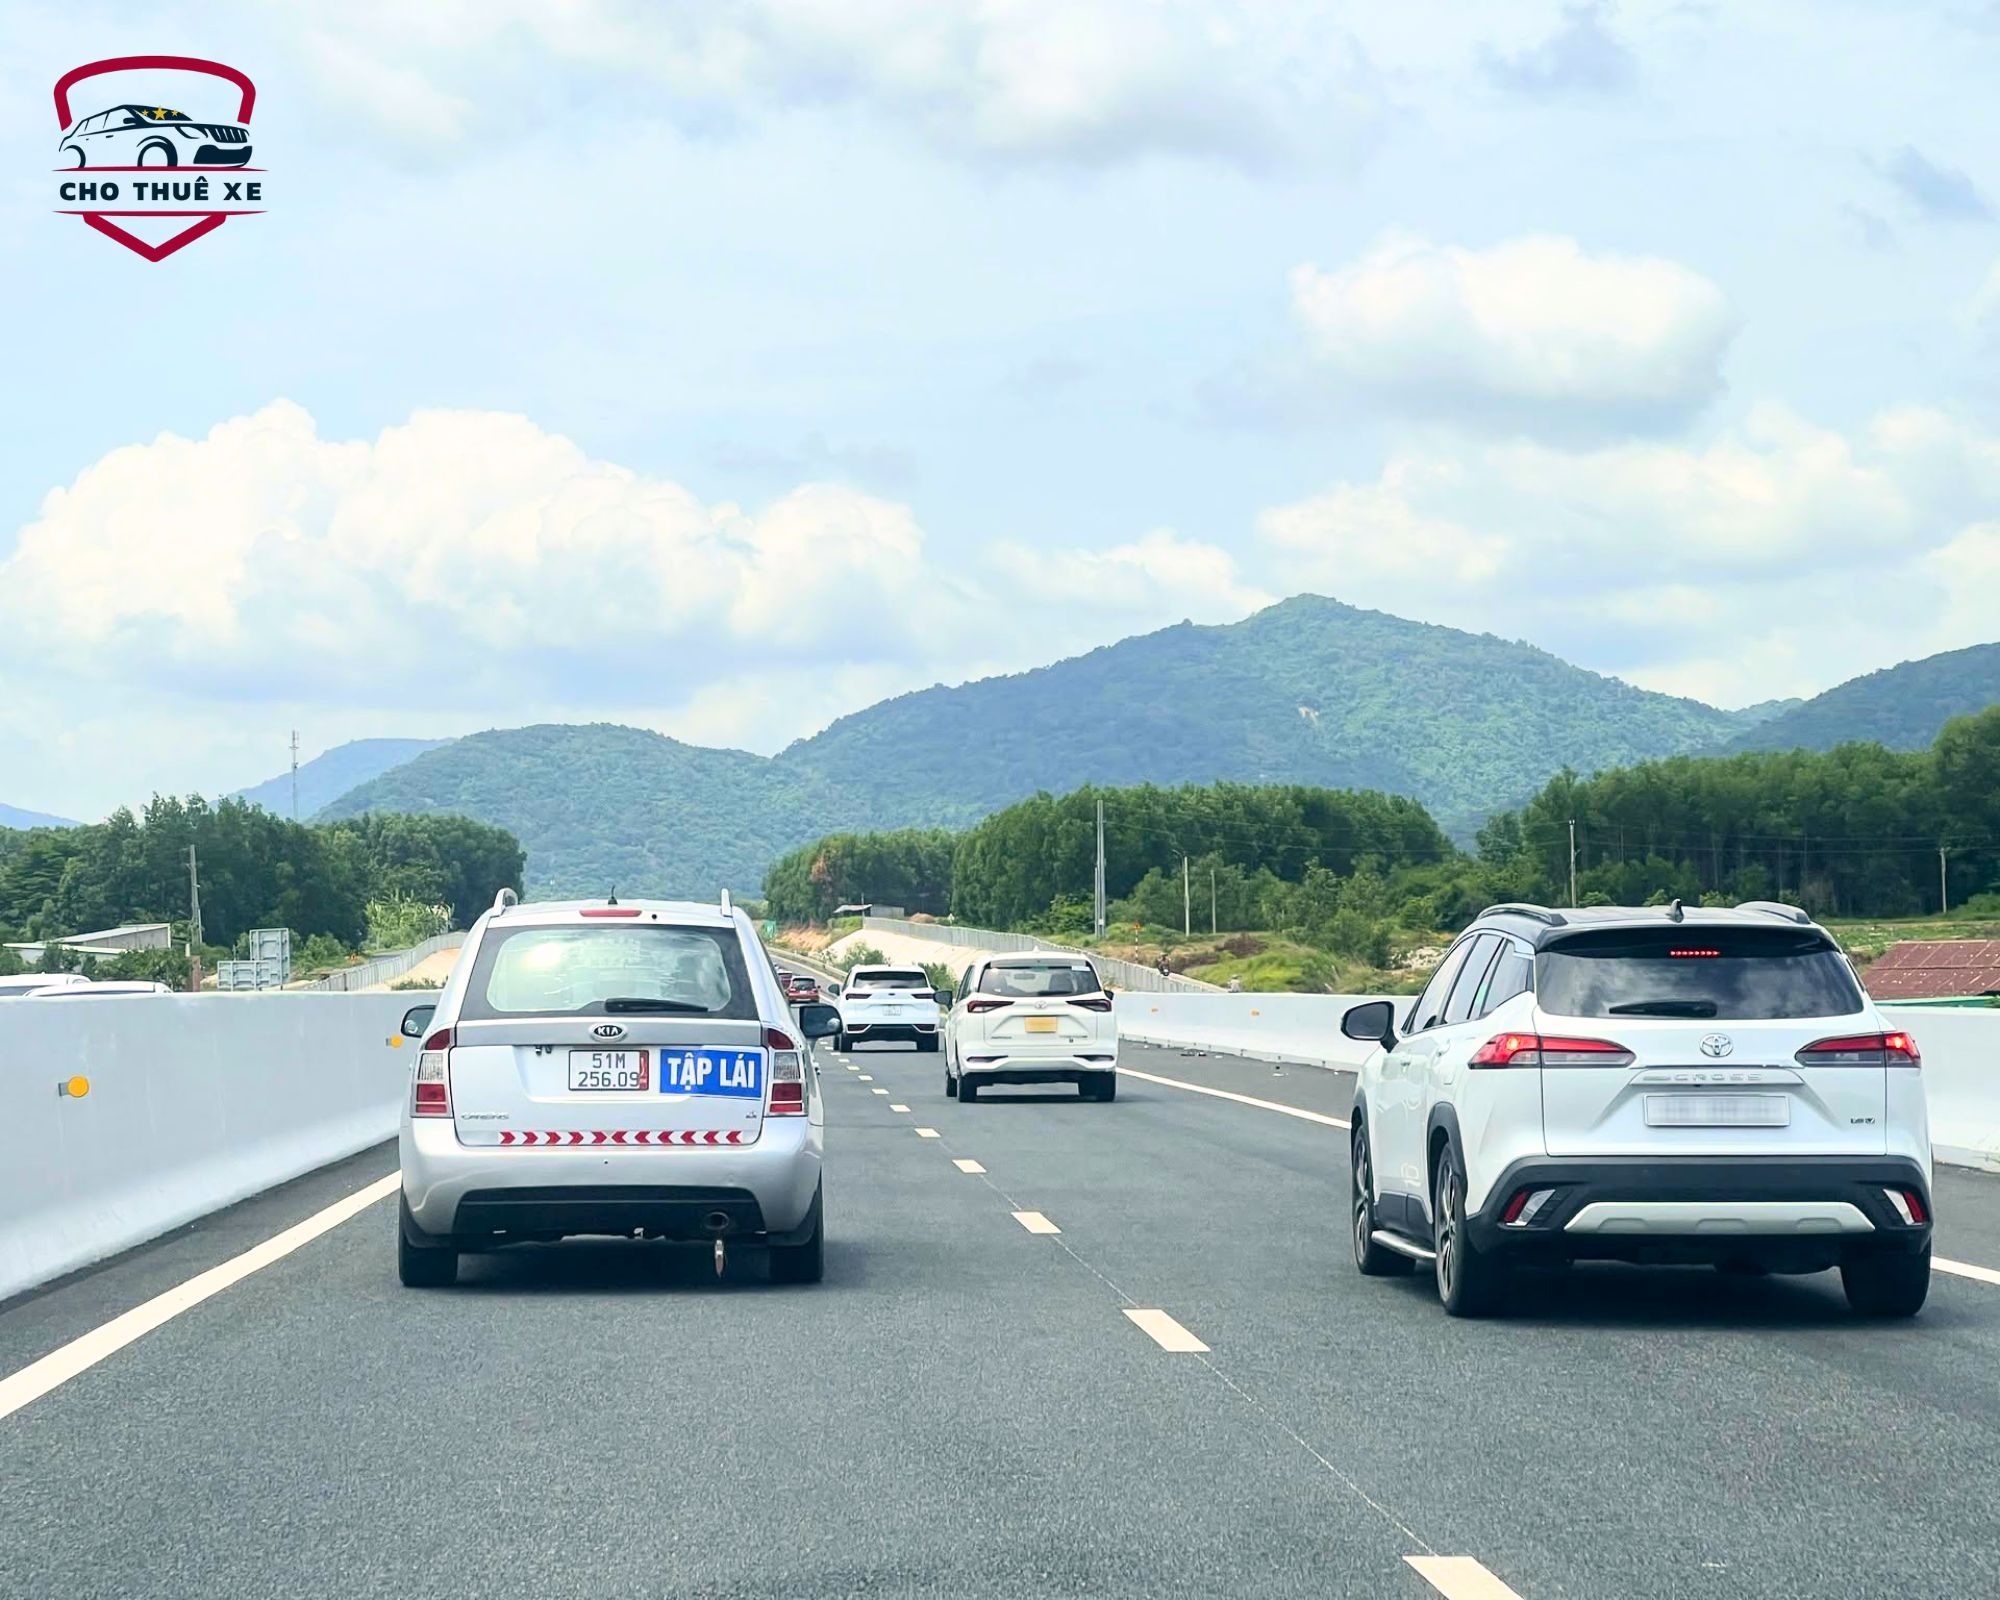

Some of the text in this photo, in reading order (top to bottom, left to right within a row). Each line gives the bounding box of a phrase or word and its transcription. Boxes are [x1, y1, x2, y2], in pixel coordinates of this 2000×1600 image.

[592, 1053, 626, 1069] 51M
[578, 1071, 640, 1088] 256.09
[668, 1052, 755, 1091] TẬP LÁI
